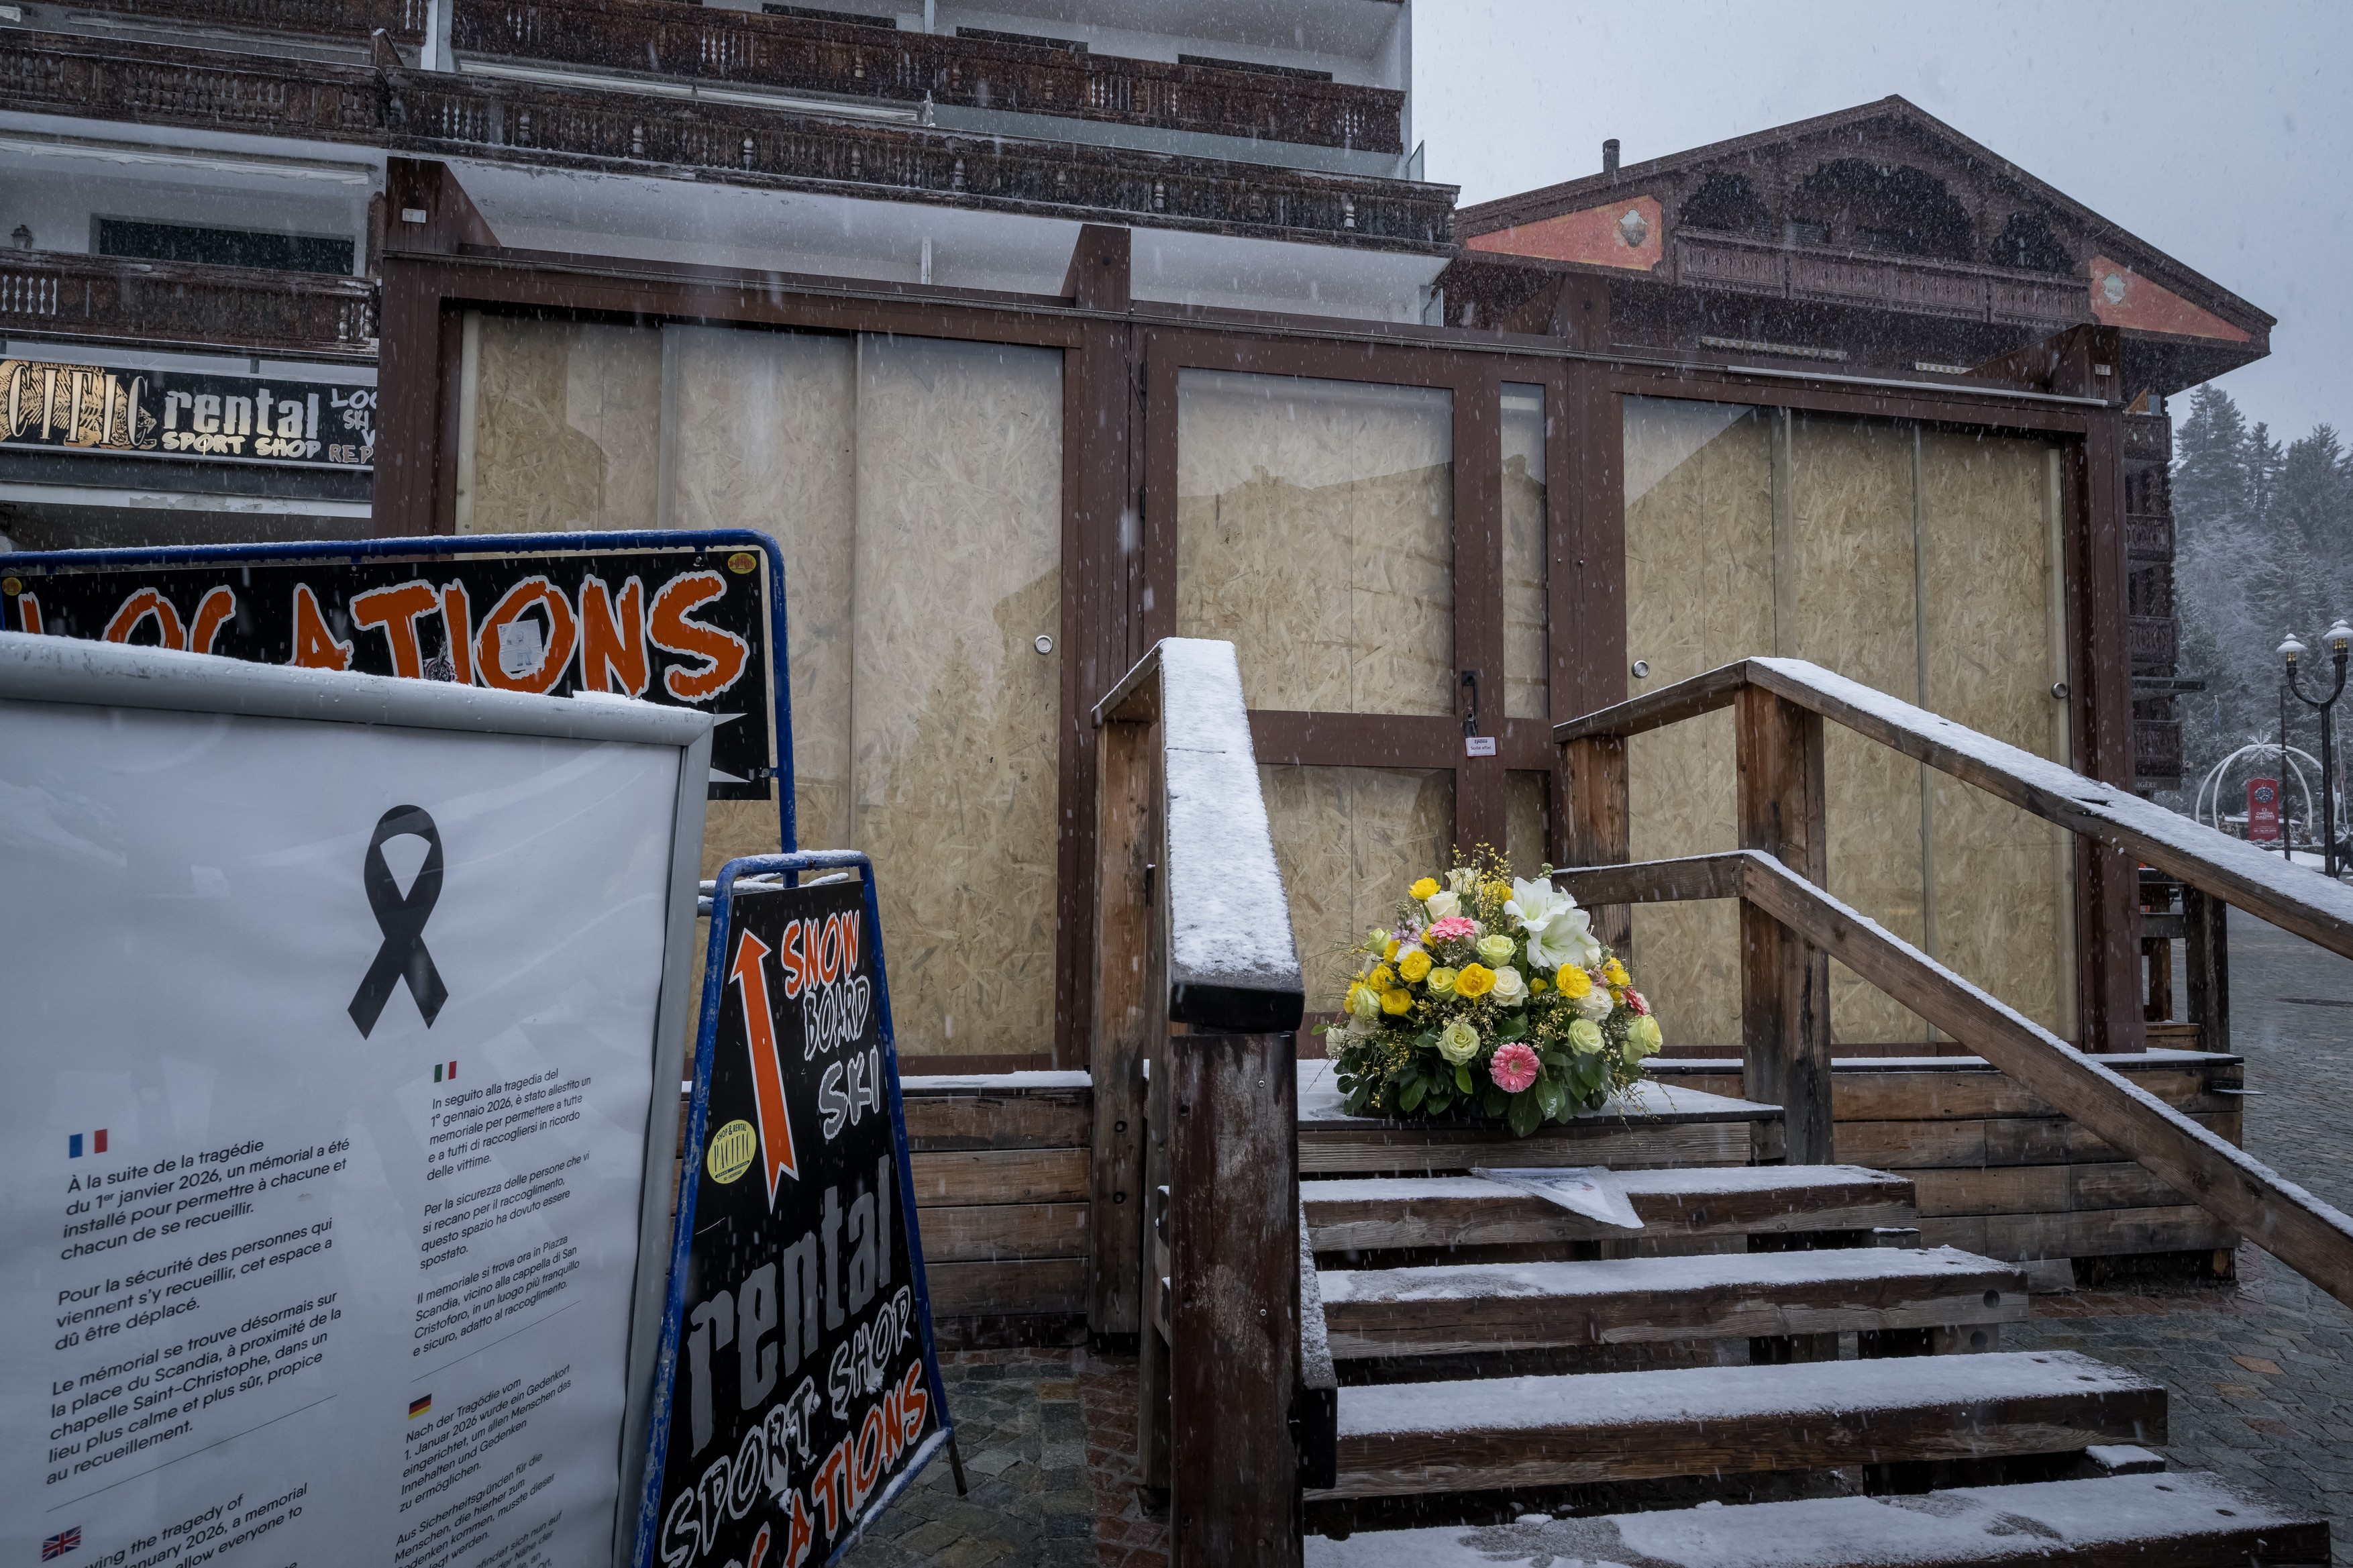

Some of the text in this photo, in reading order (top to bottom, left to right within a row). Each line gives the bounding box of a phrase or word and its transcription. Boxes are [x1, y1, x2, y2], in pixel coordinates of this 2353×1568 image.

[164, 388, 319, 439] rental
[343, 409, 368, 431] SKI
[162, 431, 374, 464] SPORT SHOP REP
[782, 910, 859, 999] SNOW
[804, 976, 870, 1061] BOARD
[430, 1095, 582, 1145] memoriale per permettere a tutte
[433, 1068, 558, 1110] In seguito alla tragedia del
[443, 1105, 484, 1127] gennaio
[487, 1096, 513, 1113] 2026,
[515, 1094, 522, 1105] è
[524, 1090, 546, 1102] stato
[548, 1080, 580, 1096] allestito
[582, 1078, 591, 1086] un
[819, 1045, 879, 1139] SKI
[428, 1110, 580, 1163] e a tutti di raccogliersi in ricordo
[714, 1131, 750, 1172] PACIFIC
[717, 1123, 747, 1142] SHOP & RENTAL
[63, 1158, 347, 1238] installé pour permettre à chacune et
[66, 1200, 90, 1216] du
[117, 1182, 175, 1208] janvier
[178, 1168, 222, 1190] 2026,
[227, 1165, 245, 1178] un
[250, 1146, 313, 1173] mémorial
[317, 1147, 324, 1157] a
[328, 1138, 350, 1154] été
[67, 1140, 264, 1194] À la suite de la tragédie
[424, 1151, 590, 1216] Per la sicurezza delle persone che vi
[427, 1155, 491, 1181] delle vittime.
[58, 1217, 332, 1306] Pour la sécurité des personnes qui
[61, 1202, 254, 1260] chacun de se recueillir.
[56, 1295, 134, 1328] viennent
[166, 1267, 236, 1297] recueillir,
[240, 1257, 266, 1274] cet
[269, 1243, 321, 1265] espace
[325, 1239, 332, 1249] a
[687, 1153, 891, 1457] rental
[53, 1292, 337, 1396] Le mémorial se trouve désormais sur
[55, 1297, 200, 1350] dû être déplacé.
[50, 1404, 128, 1440] chapelle
[275, 1340, 308, 1359] dans
[312, 1332, 327, 1345] un
[52, 1308, 341, 1418] la place du Scandia, à proximité de la
[49, 1353, 323, 1463] lieu plus calme et plus sûr, propice
[403, 1380, 571, 1477] eingerichtet, um allen Menschen das
[405, 1364, 570, 1461] 1. Januar 2026 wurde ein Gedenkort
[406, 1379, 521, 1444] Nach der Tragödie vom
[661, 1285, 912, 1568] SPORT SHOP
[46, 1420, 193, 1485] au recueillement.
[401, 1420, 527, 1496] Innehalten und Gedenken
[130, 1493, 244, 1555] the tragedy of
[186, 1482, 307, 1550] 2026, a memorial
[218, 1507, 302, 1553] everyone to
